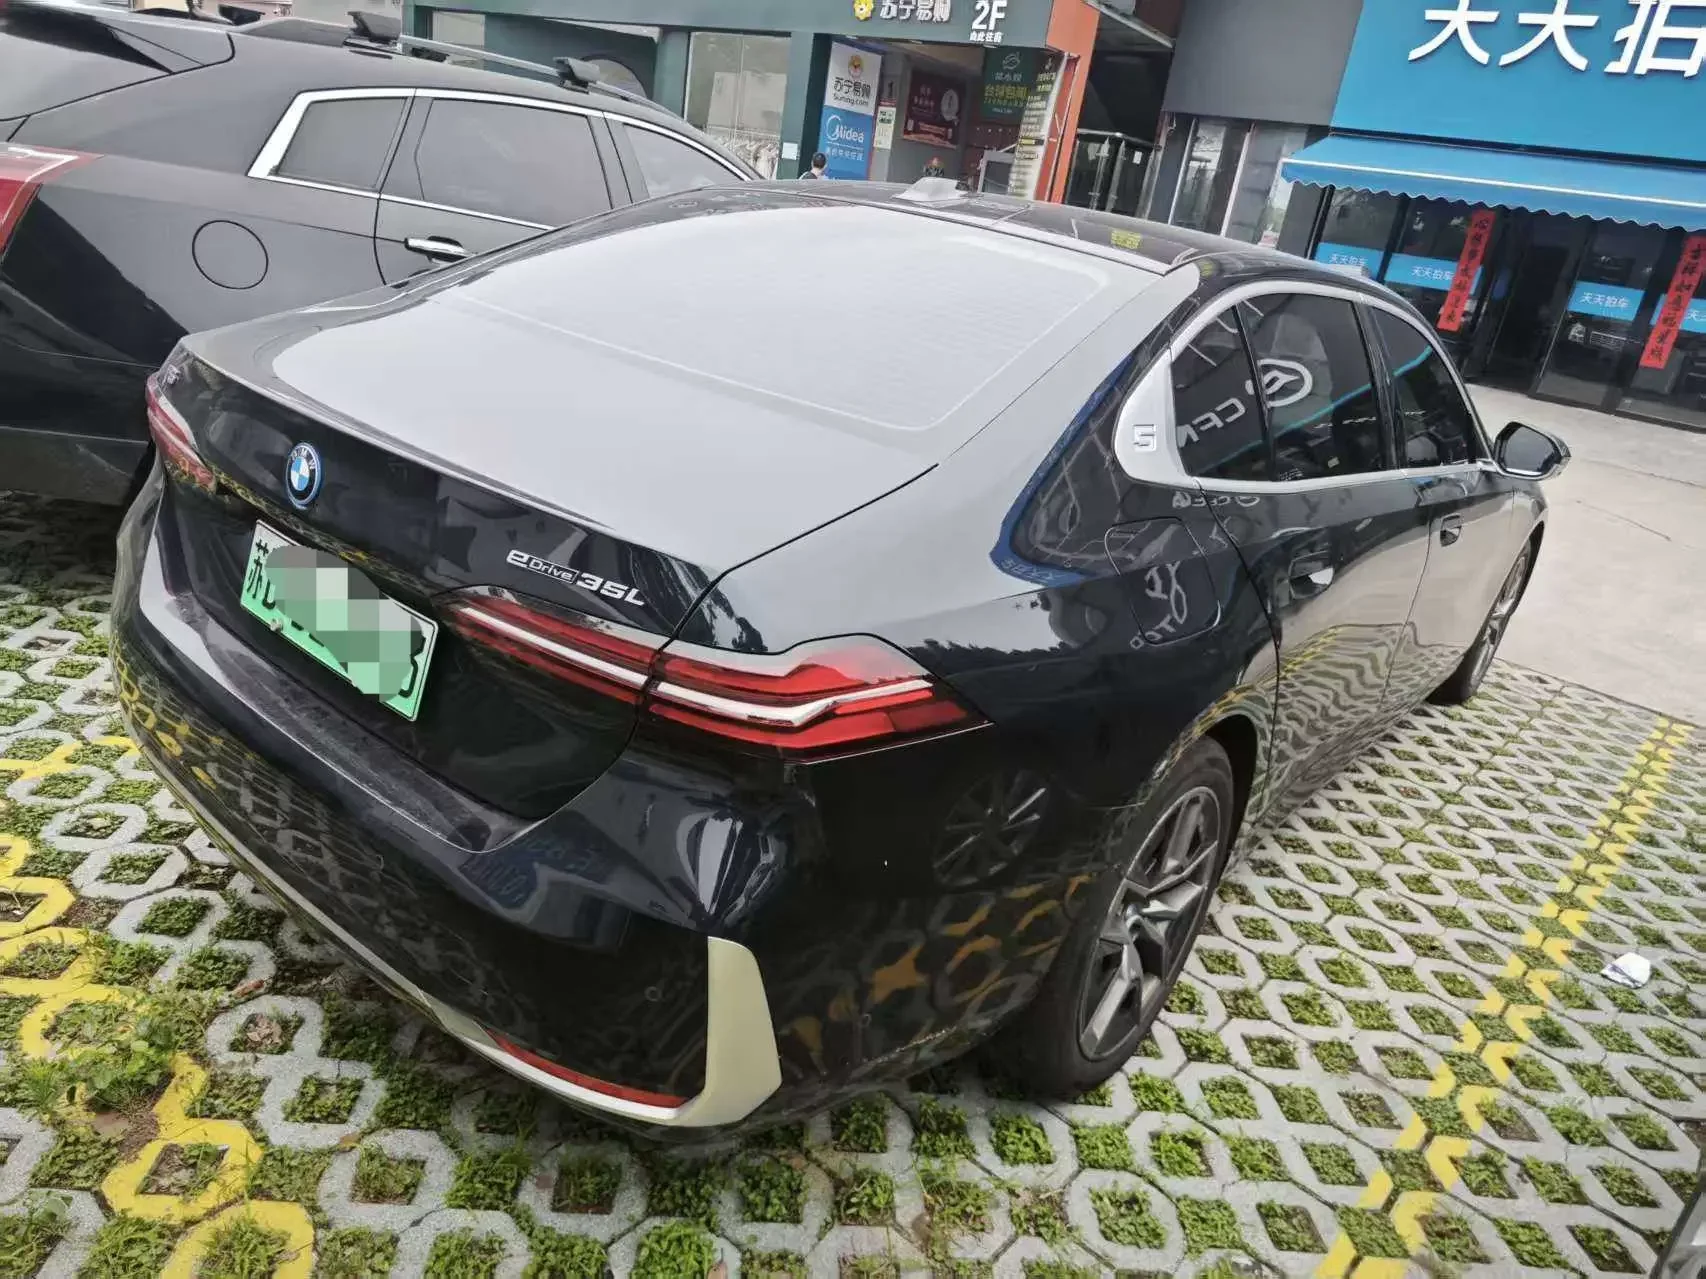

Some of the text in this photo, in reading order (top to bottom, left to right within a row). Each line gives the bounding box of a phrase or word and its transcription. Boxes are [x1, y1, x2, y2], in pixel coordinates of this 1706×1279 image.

[880, 0, 950, 22] 苏宁易购
[971, 0, 1008, 31] 2F
[833, 77, 871, 98] 苏宁易购
[826, 114, 865, 143] Midea
